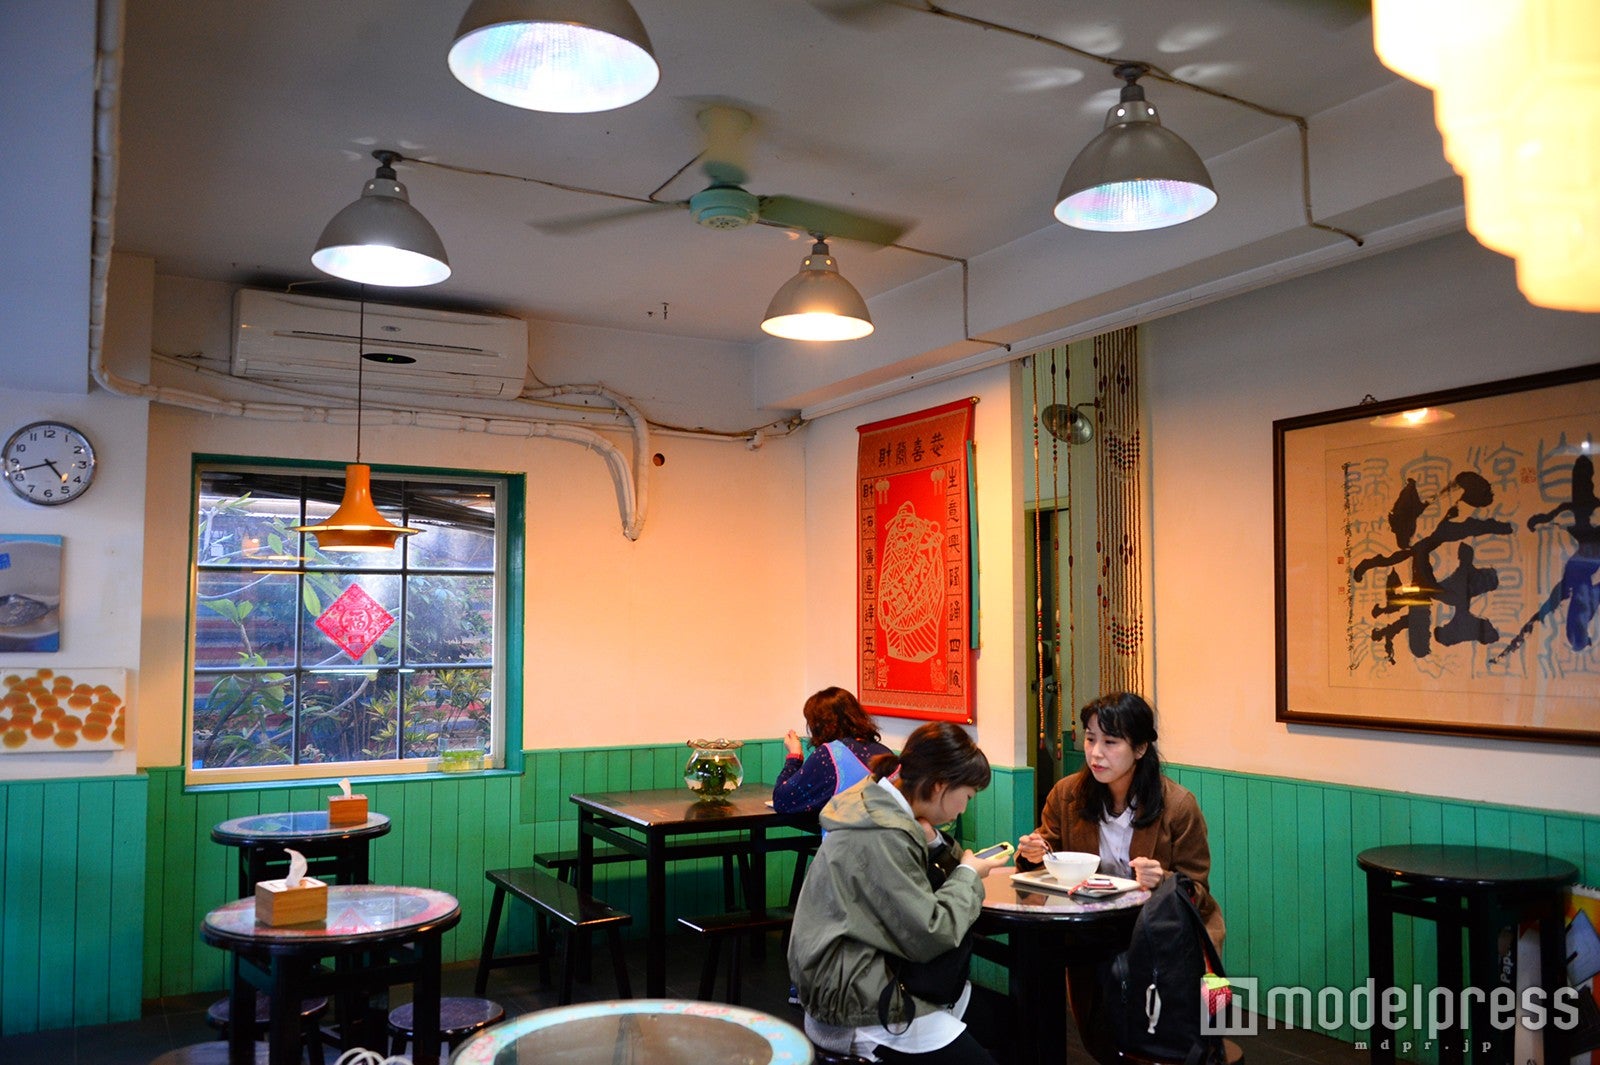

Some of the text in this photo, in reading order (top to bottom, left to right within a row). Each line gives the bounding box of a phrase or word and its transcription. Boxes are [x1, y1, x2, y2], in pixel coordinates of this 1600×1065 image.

[30, 433, 37, 442] 11
[44, 430, 56, 439] 12
[65, 434, 68, 442] 1
[16, 444, 26, 453] 10
[74, 446, 82, 454] 2
[10, 458, 19, 466] 9
[78, 461, 87, 469] 3
[15, 473, 25, 482] 8
[27, 485, 35, 493] 7
[61, 486, 70, 494] 5
[43, 489, 53, 498] 6
